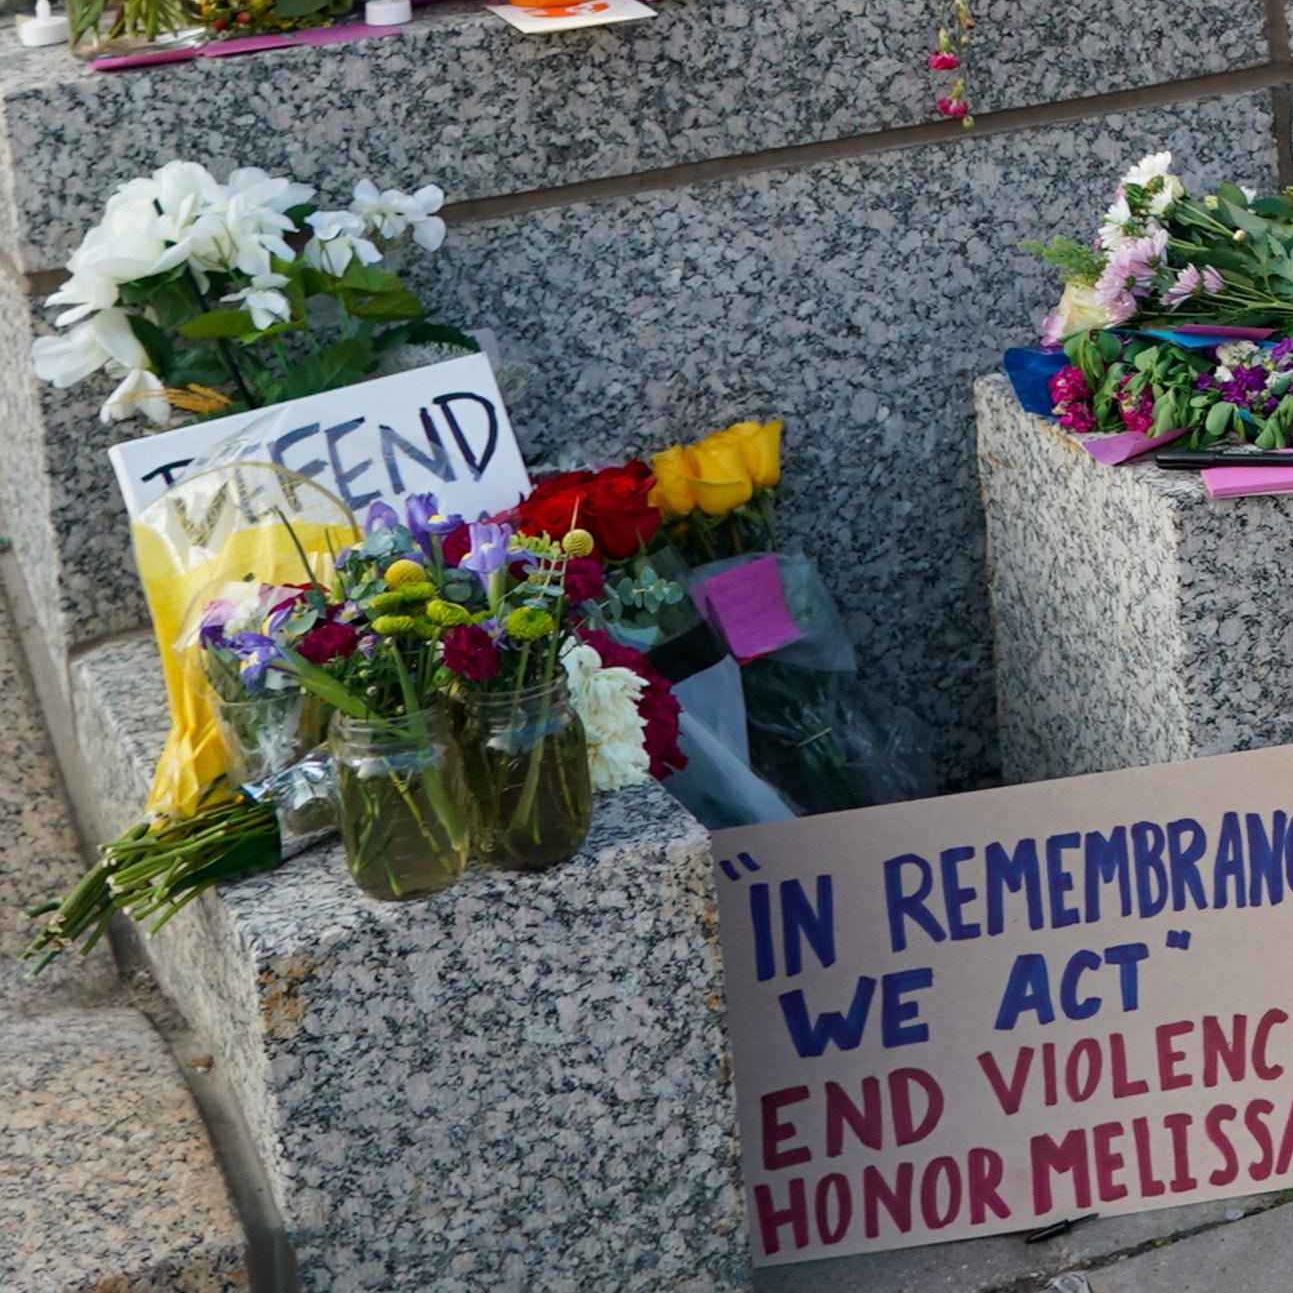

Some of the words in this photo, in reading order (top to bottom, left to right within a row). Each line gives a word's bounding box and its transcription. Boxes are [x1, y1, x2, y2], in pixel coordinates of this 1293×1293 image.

[778, 967, 933, 1058] WE
[760, 1068, 943, 1170] END
[754, 1147, 1011, 1255] HONOR
